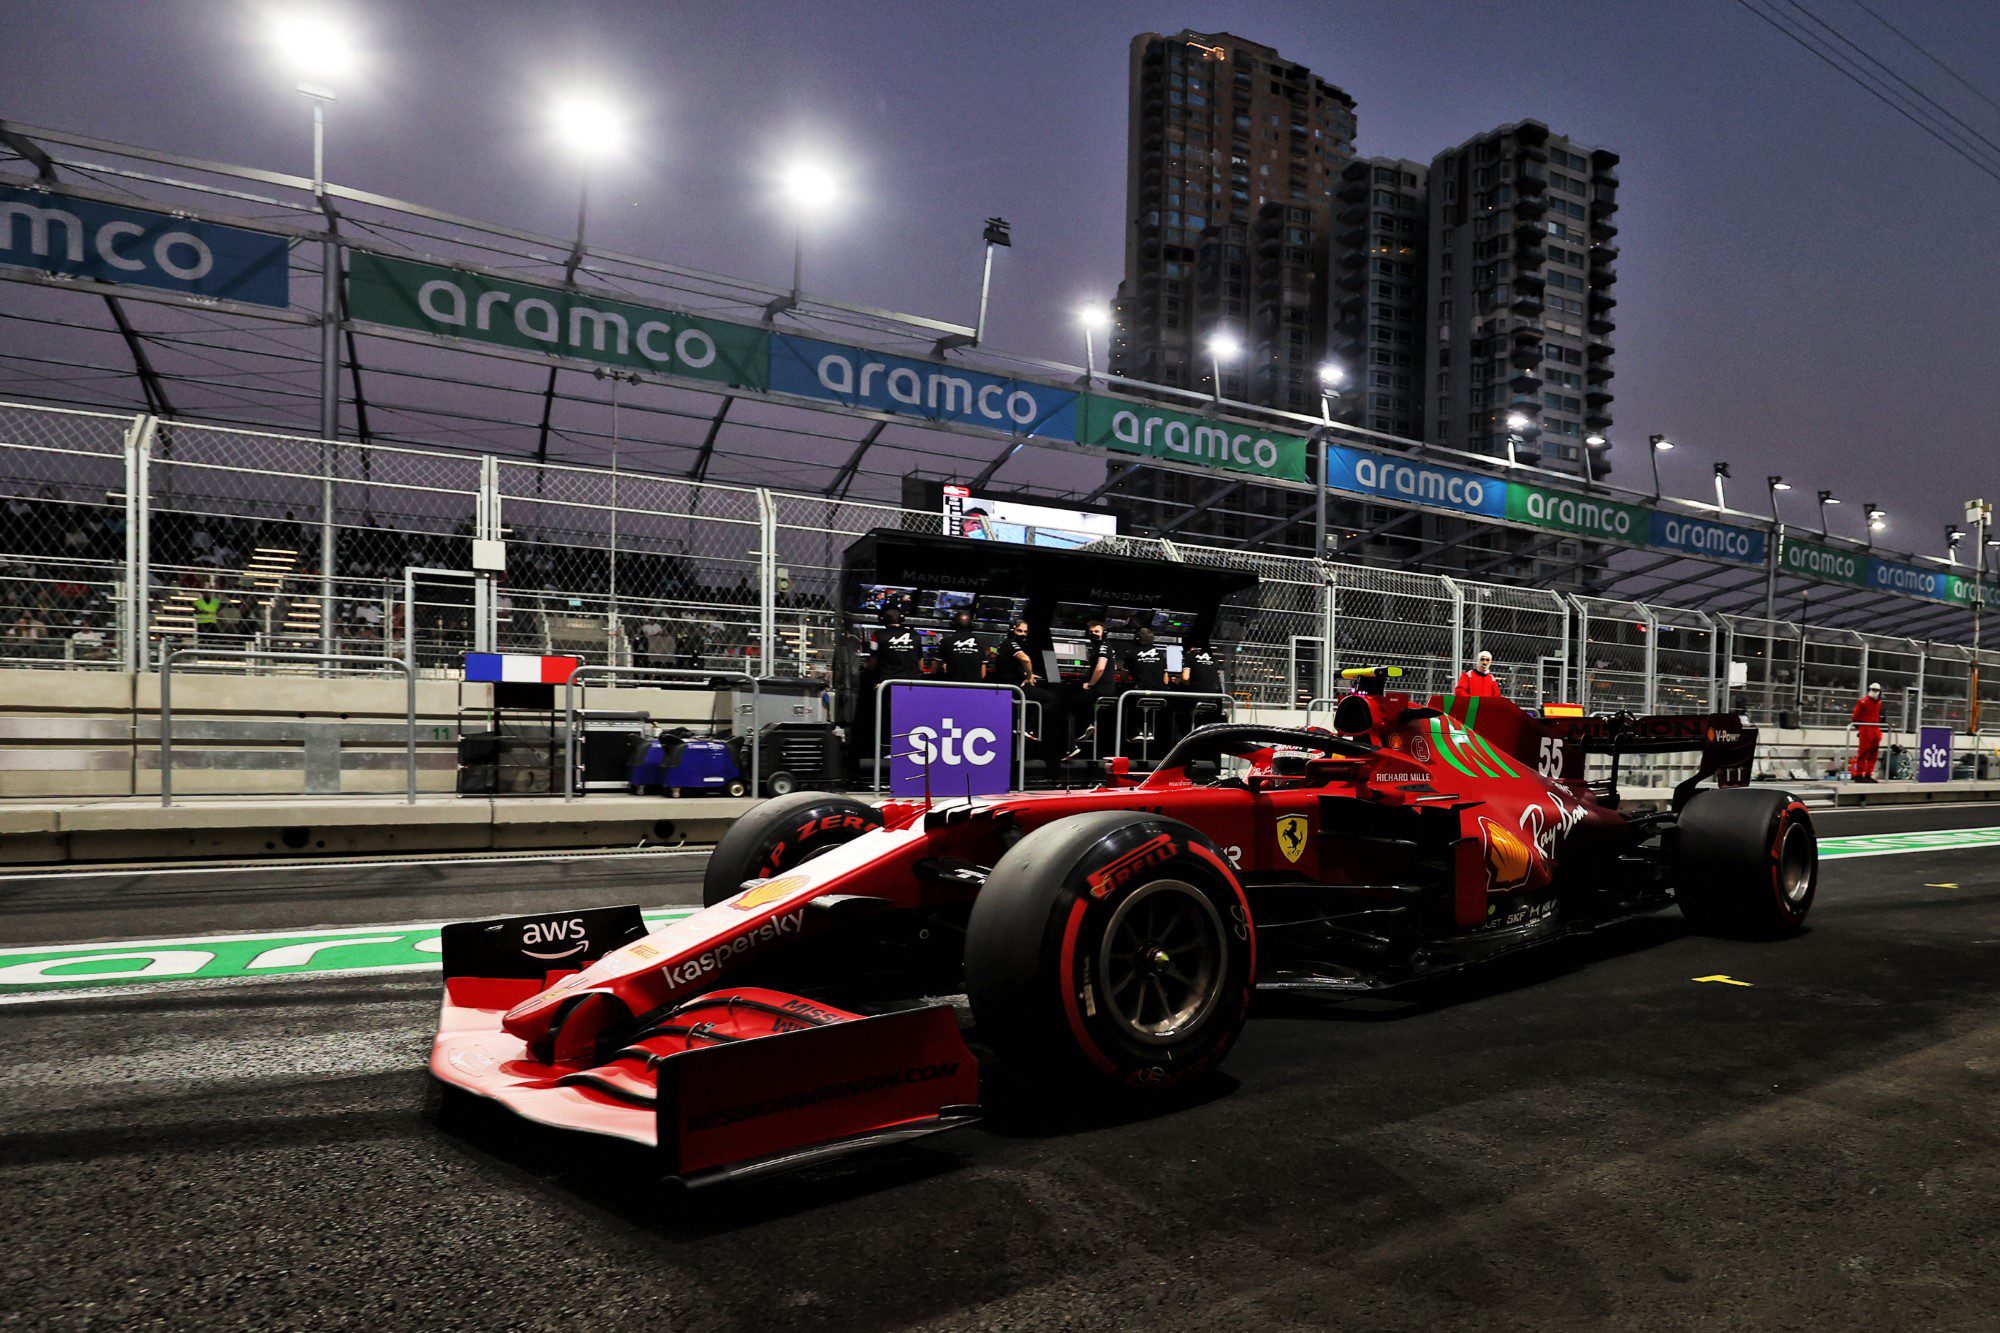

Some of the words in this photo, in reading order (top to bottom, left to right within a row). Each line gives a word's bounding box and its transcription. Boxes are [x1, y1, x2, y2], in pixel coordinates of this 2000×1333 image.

[418, 280, 716, 368] aramco
[818, 355, 1037, 424] aramco
[1112, 410, 1277, 468] aramco
[1355, 459, 1483, 506] aramco
[1527, 493, 1630, 534] aramco
[1666, 520, 1748, 555] aramco
[1789, 546, 1854, 578] aramco
[1877, 564, 1935, 592] aramco
[432, 727, 450, 740] 11
[907, 718, 997, 766] stc
[1538, 737, 1564, 780] 55
[1923, 744, 1947, 768] stc
[1376, 773, 1409, 782] RICHARD
[1410, 773, 1431, 782] MILLE
[523, 918, 586, 945] aws
[661, 908, 805, 990] kaspersky
